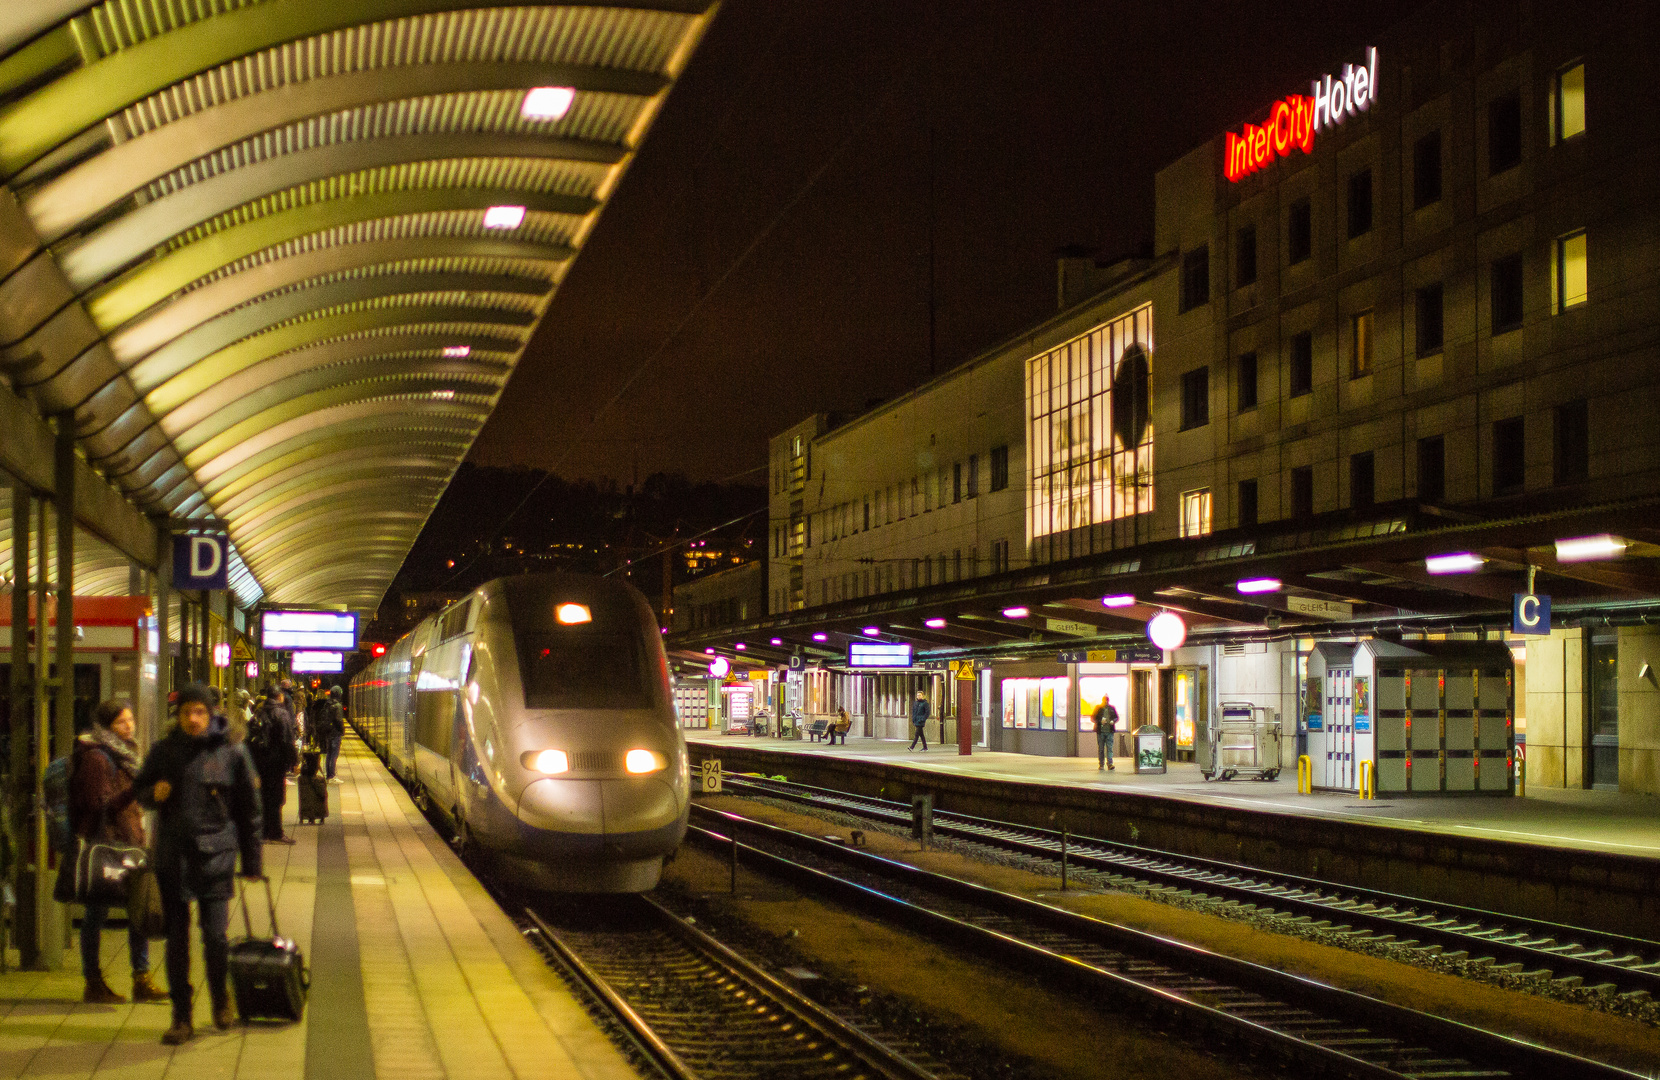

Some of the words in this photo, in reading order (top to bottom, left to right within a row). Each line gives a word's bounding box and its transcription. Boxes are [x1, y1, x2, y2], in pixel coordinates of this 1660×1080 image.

[191, 537, 222, 576] D
[1300, 603, 1323, 611] GLEIS
[1519, 595, 1541, 626] C
[791, 656, 801, 668] D
[703, 762, 720, 774] 94
[707, 776, 717, 789] 0
